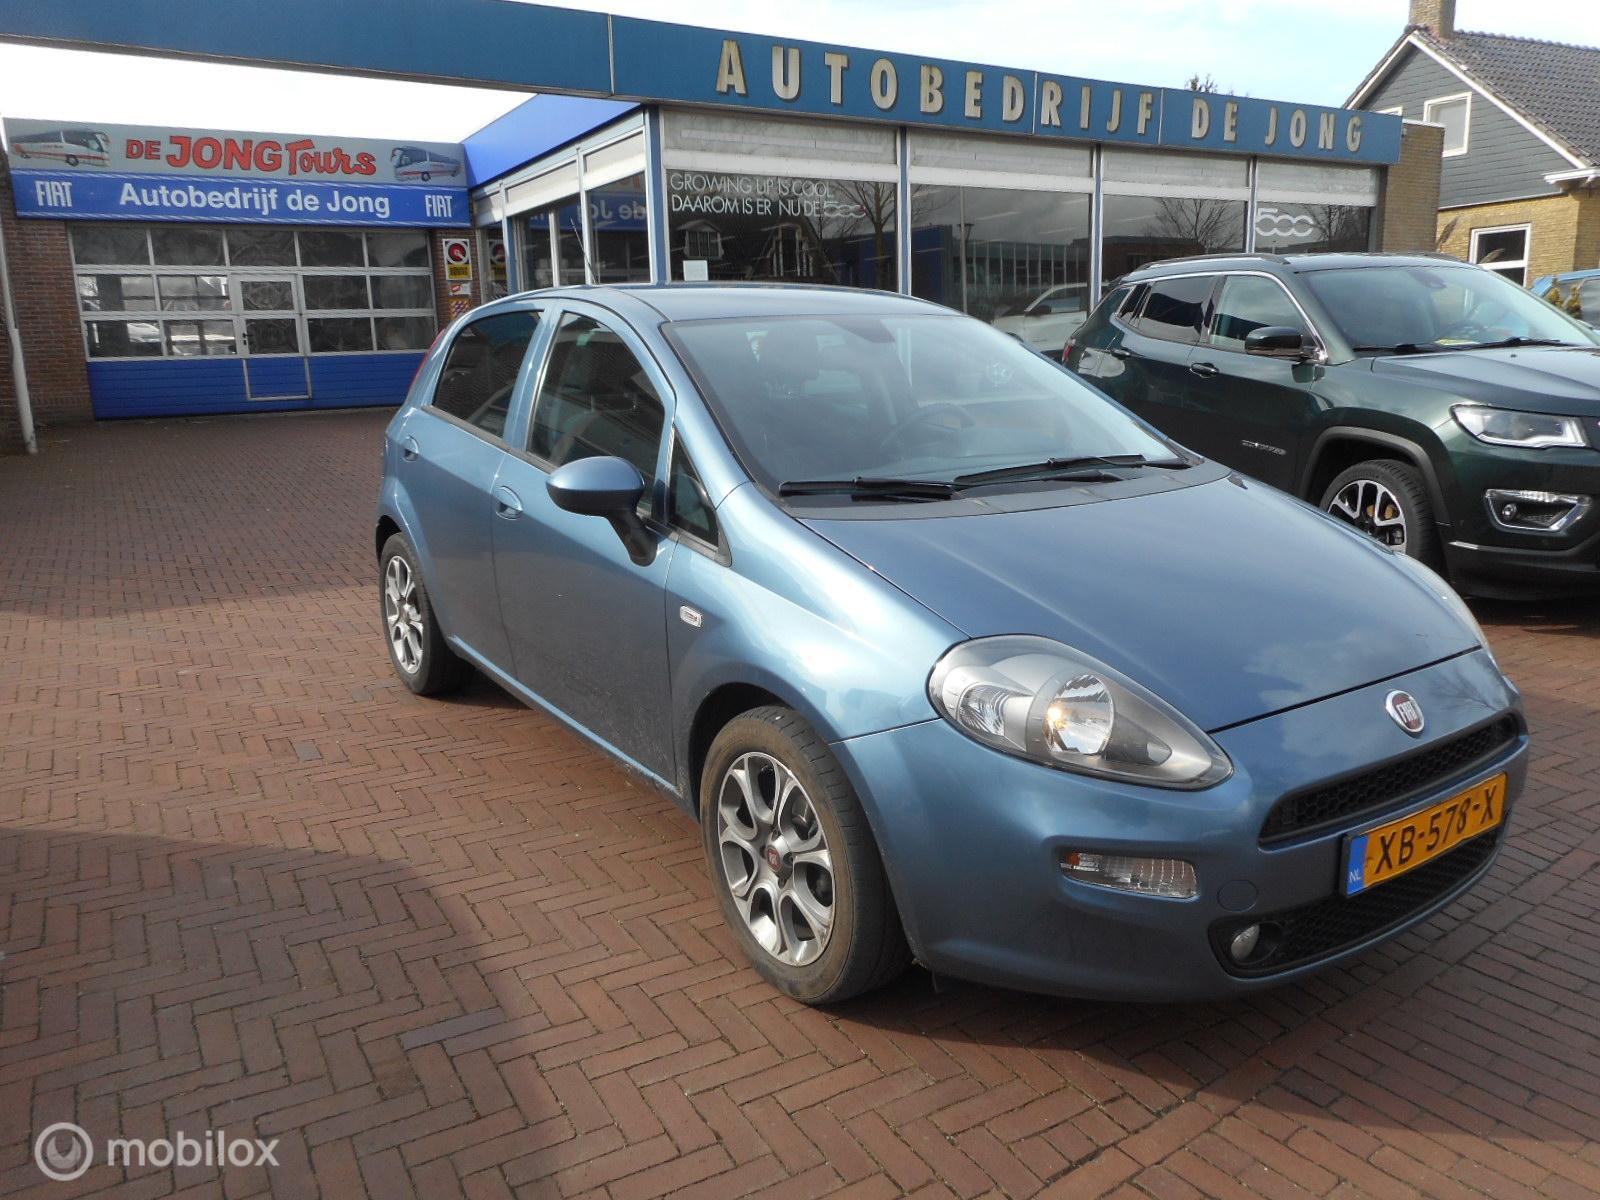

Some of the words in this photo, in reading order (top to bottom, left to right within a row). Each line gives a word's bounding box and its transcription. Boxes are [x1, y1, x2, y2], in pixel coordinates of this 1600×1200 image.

[716, 39, 1154, 136] AUTOBEDRIJF
[1191, 98, 1238, 142] DE
[1265, 107, 1364, 152] JONG
[126, 139, 161, 160] DE
[166, 135, 283, 172] JONG
[285, 139, 377, 175] Tours
[35, 181, 73, 208] FIAT
[670, 173, 752, 194] GROWING
[756, 178, 774, 194] UP
[778, 179, 789, 196] IS
[791, 180, 834, 198] COOL
[119, 182, 278, 216] Autobedrijf
[286, 189, 320, 211] de
[326, 190, 391, 218] Jong
[425, 195, 453, 218] FIAT
[671, 194, 740, 213] DAAROM
[742, 198, 753, 215] IS
[757, 199, 772, 216] ER
[779, 200, 800, 217] NU
[803, 201, 821, 217] DE
[1255, 207, 1314, 237] 500
[1375, 783, 1497, 874] XB-578-X
[1349, 868, 1361, 882] NL
